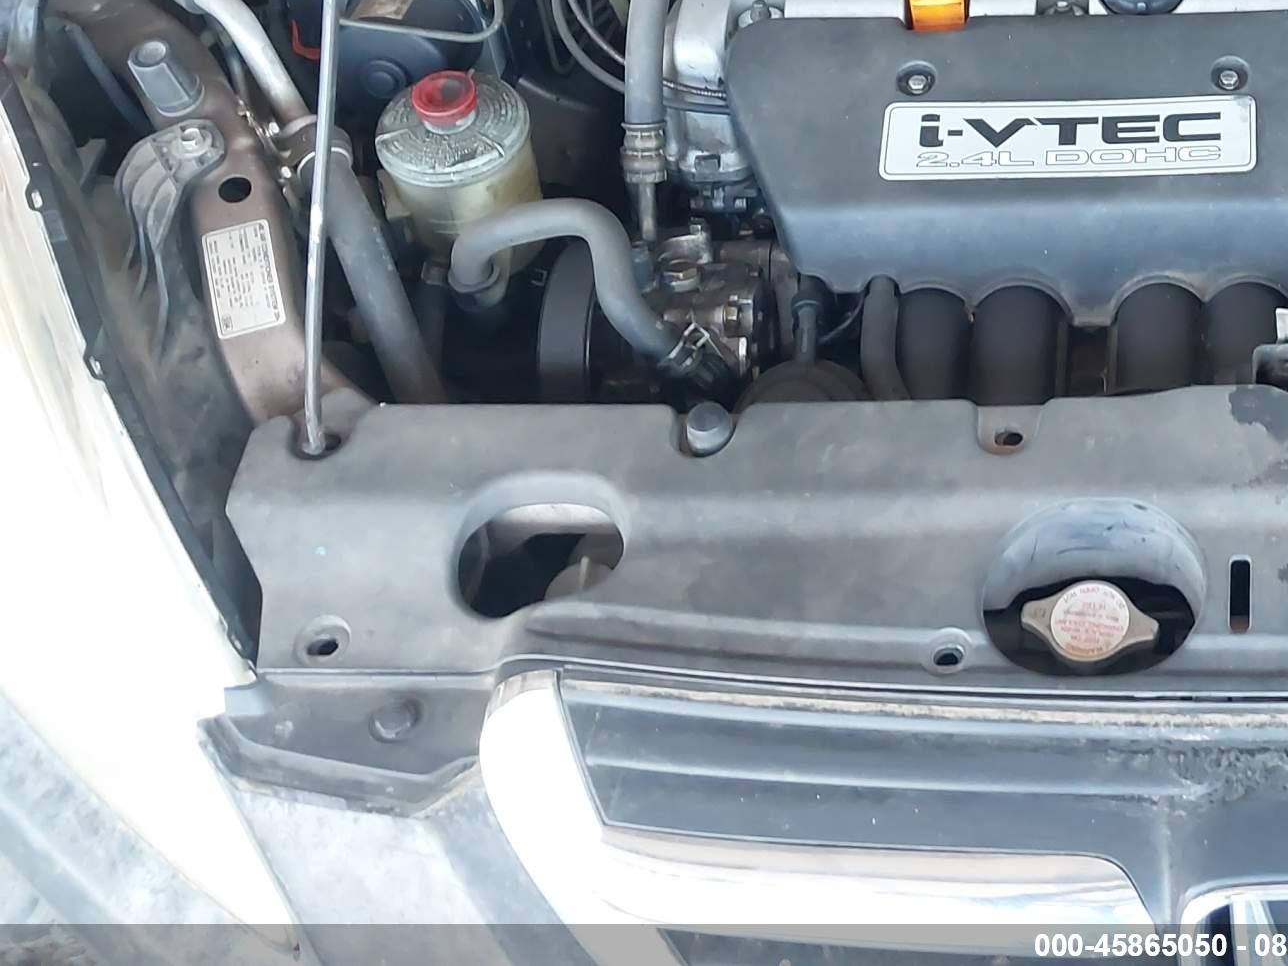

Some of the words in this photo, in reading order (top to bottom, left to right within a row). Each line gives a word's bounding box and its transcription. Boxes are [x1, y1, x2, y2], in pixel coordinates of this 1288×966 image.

[919, 112, 1222, 148] i-VTEC
[915, 150, 1035, 168] 2.4L
[1045, 145, 1222, 166] DOHC
